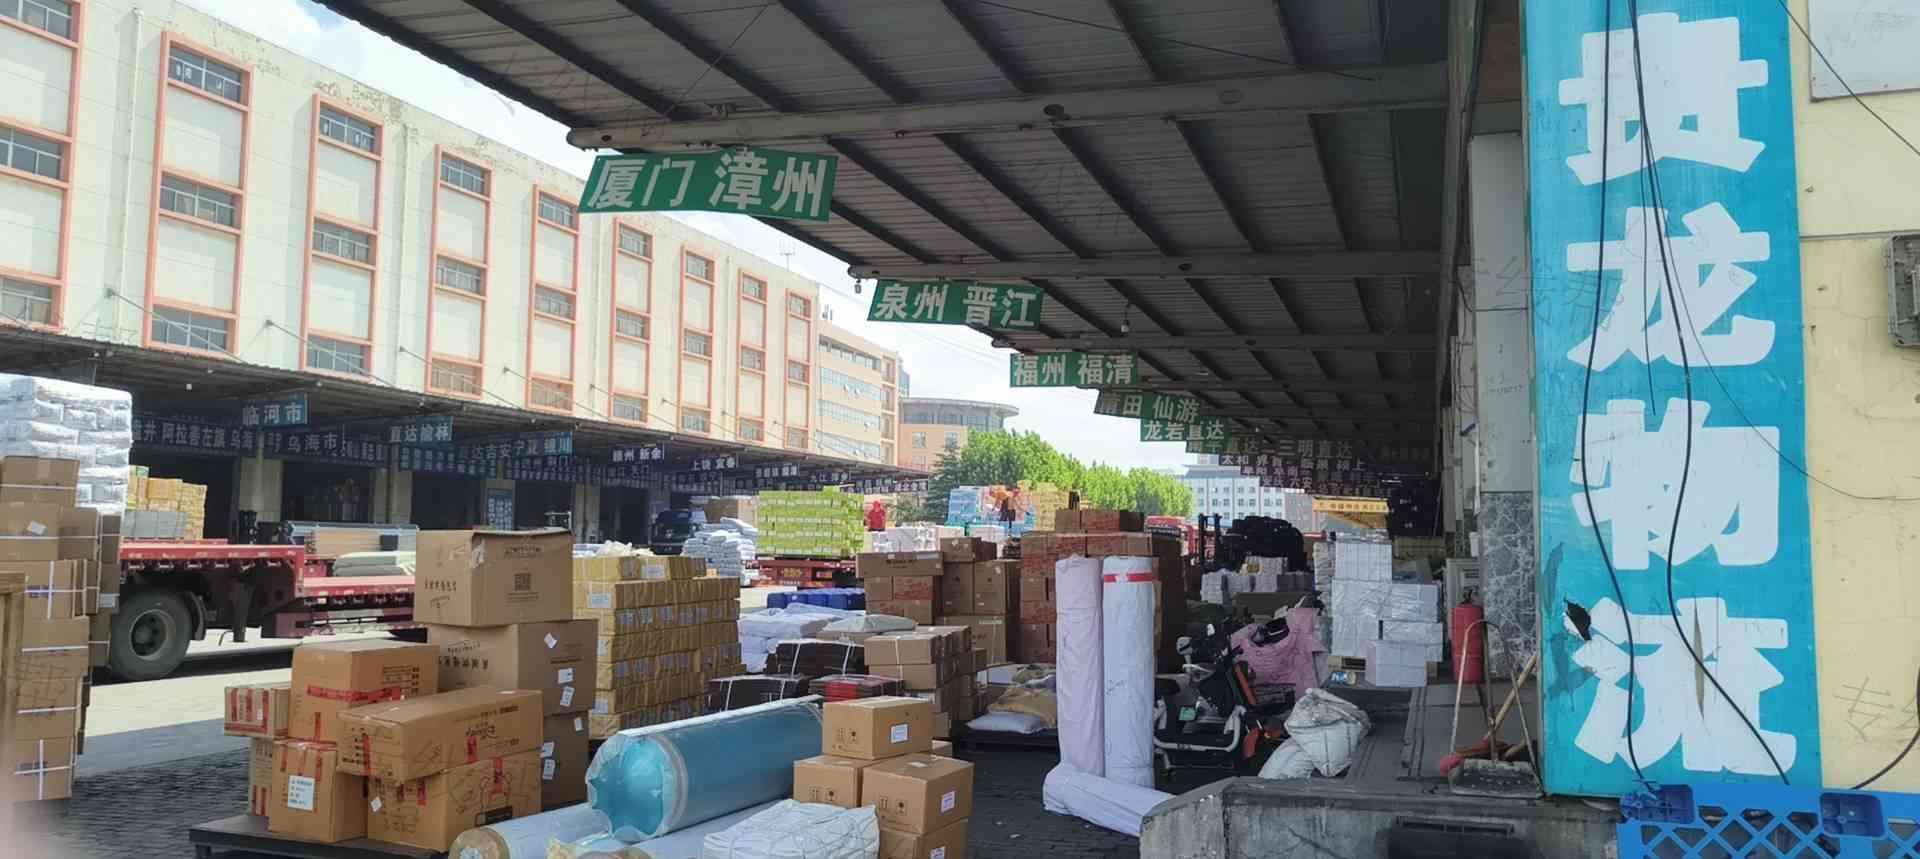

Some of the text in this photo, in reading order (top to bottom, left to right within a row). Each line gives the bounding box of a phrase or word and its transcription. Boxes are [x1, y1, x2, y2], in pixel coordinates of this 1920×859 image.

[588, 147, 828, 217] 厦门 漳州
[874, 284, 1036, 328] 泉州 晋江
[1015, 354, 1134, 386] 福州 福清
[1152, 394, 1201, 424] 仙游
[1558, 12, 1797, 776] 贵龙物流
[242, 402, 305, 425] 临河市
[288, 432, 339, 454] 乌海市
[1144, 419, 1225, 441] 龙岩直达
